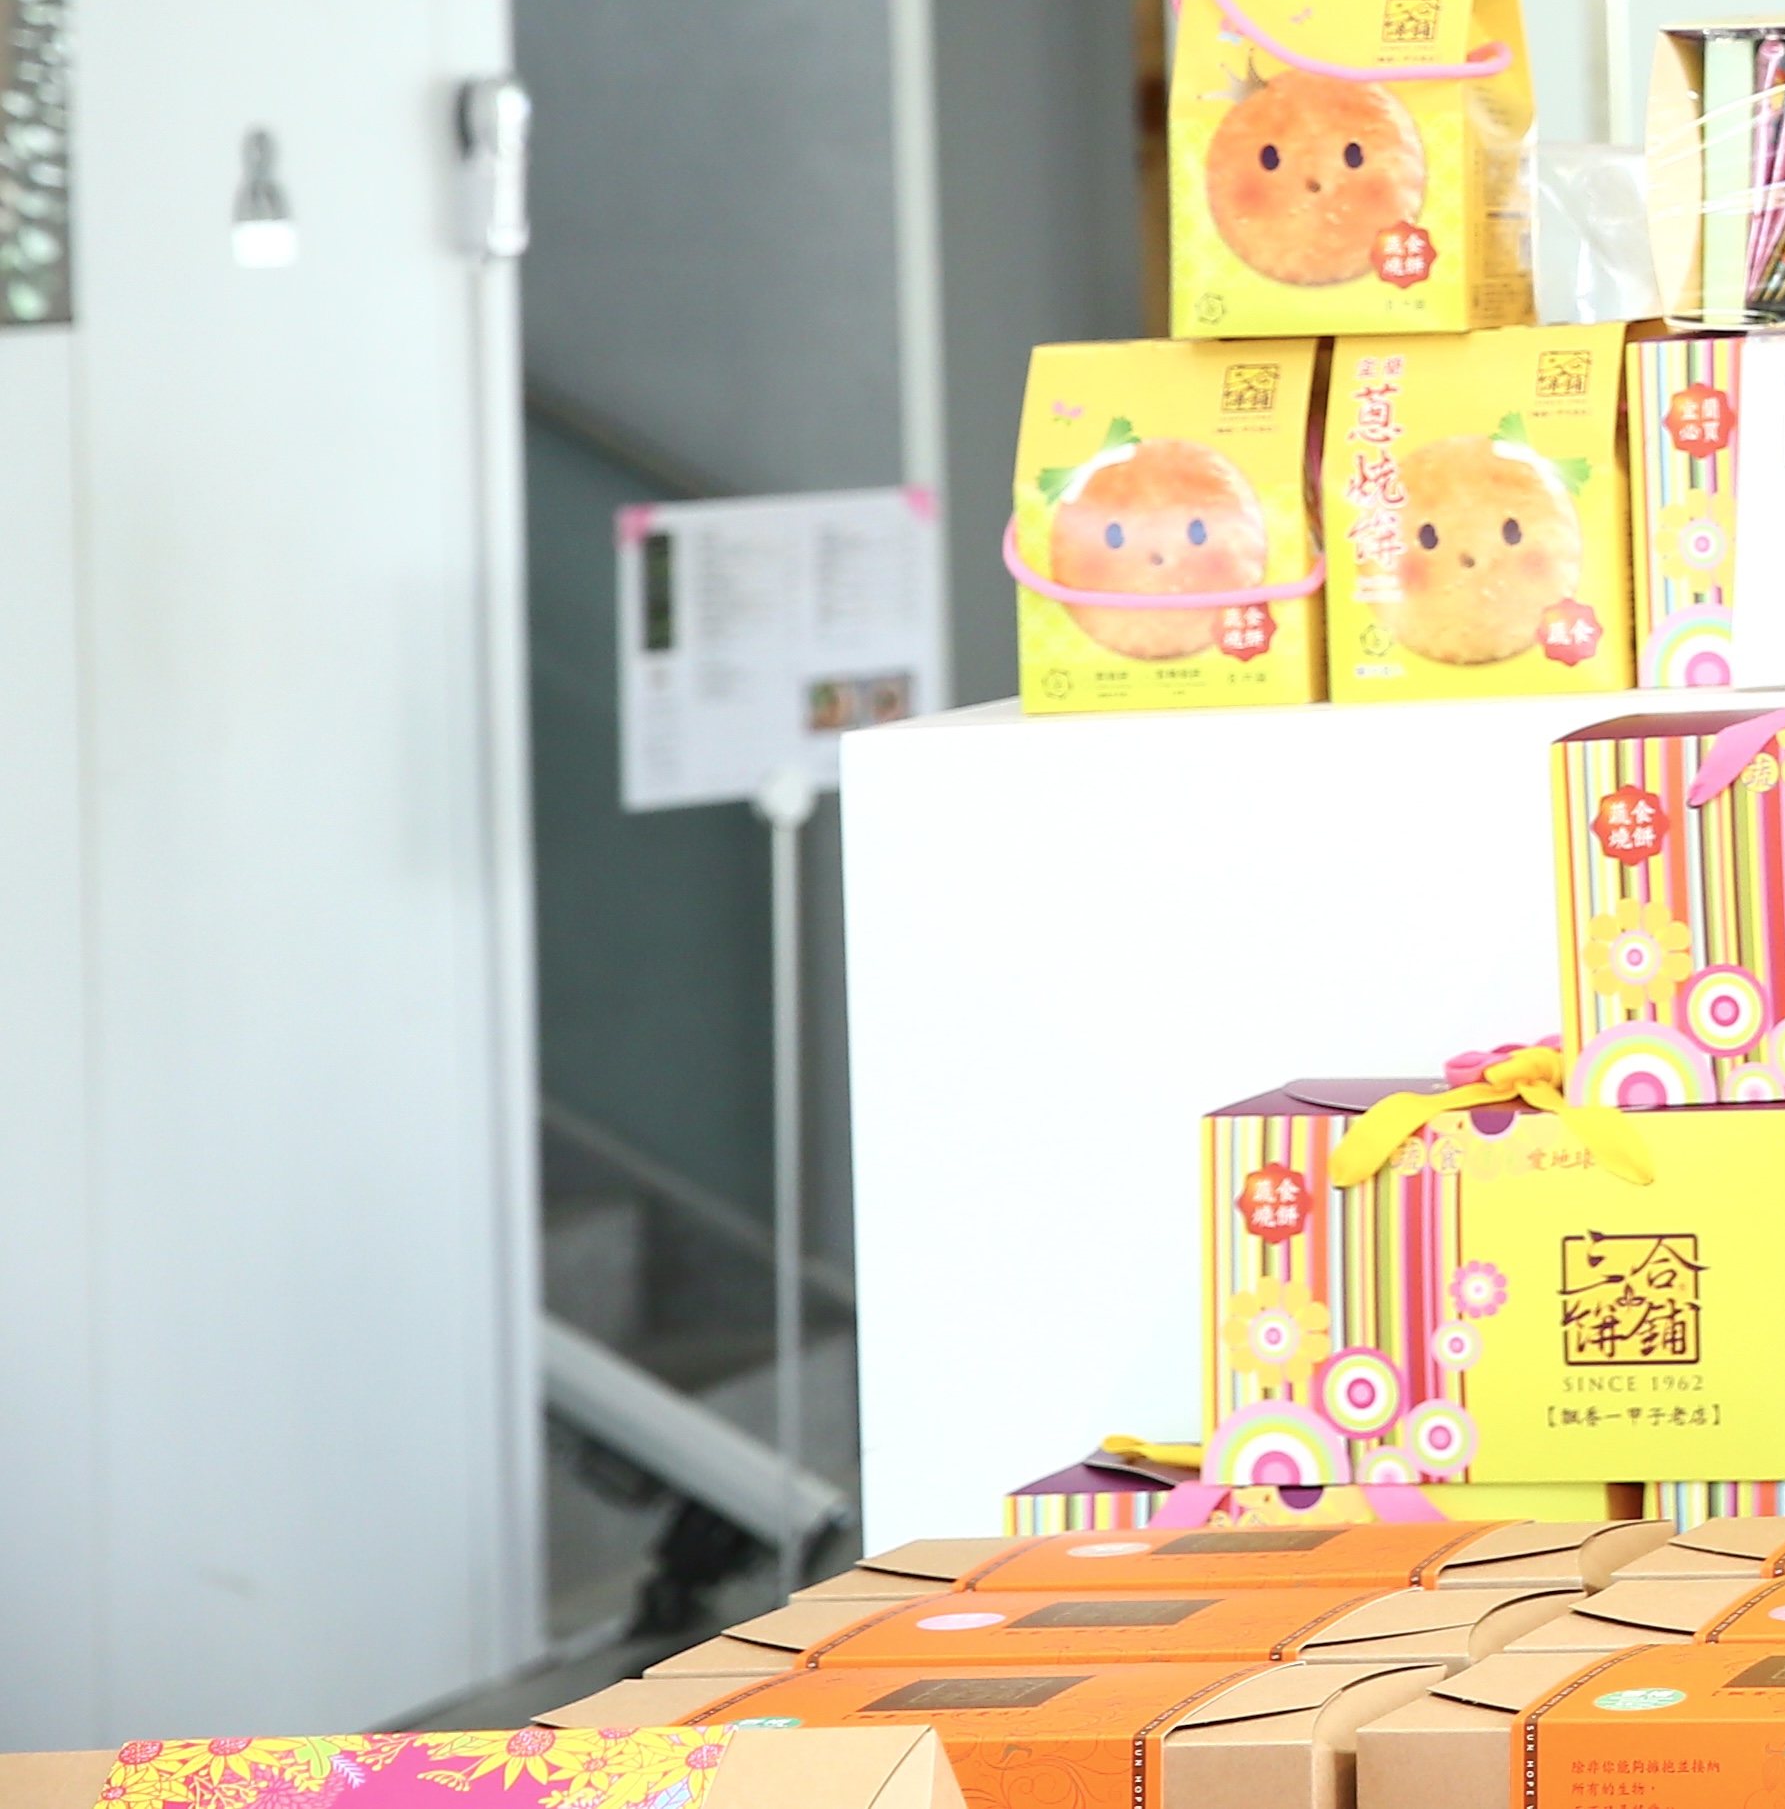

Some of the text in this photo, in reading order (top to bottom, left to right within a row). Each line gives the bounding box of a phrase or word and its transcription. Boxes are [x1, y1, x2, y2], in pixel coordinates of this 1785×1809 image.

[1546, 618, 1596, 647] 蔬食
[1608, 799, 1656, 826] 蔬食
[1251, 1176, 1300, 1203] 蔬食
[1563, 1374, 1704, 1393] SINCE 1962
[1134, 1740, 1143, 1767] SUN
[1526, 1725, 1535, 1796] SUN HOPE
